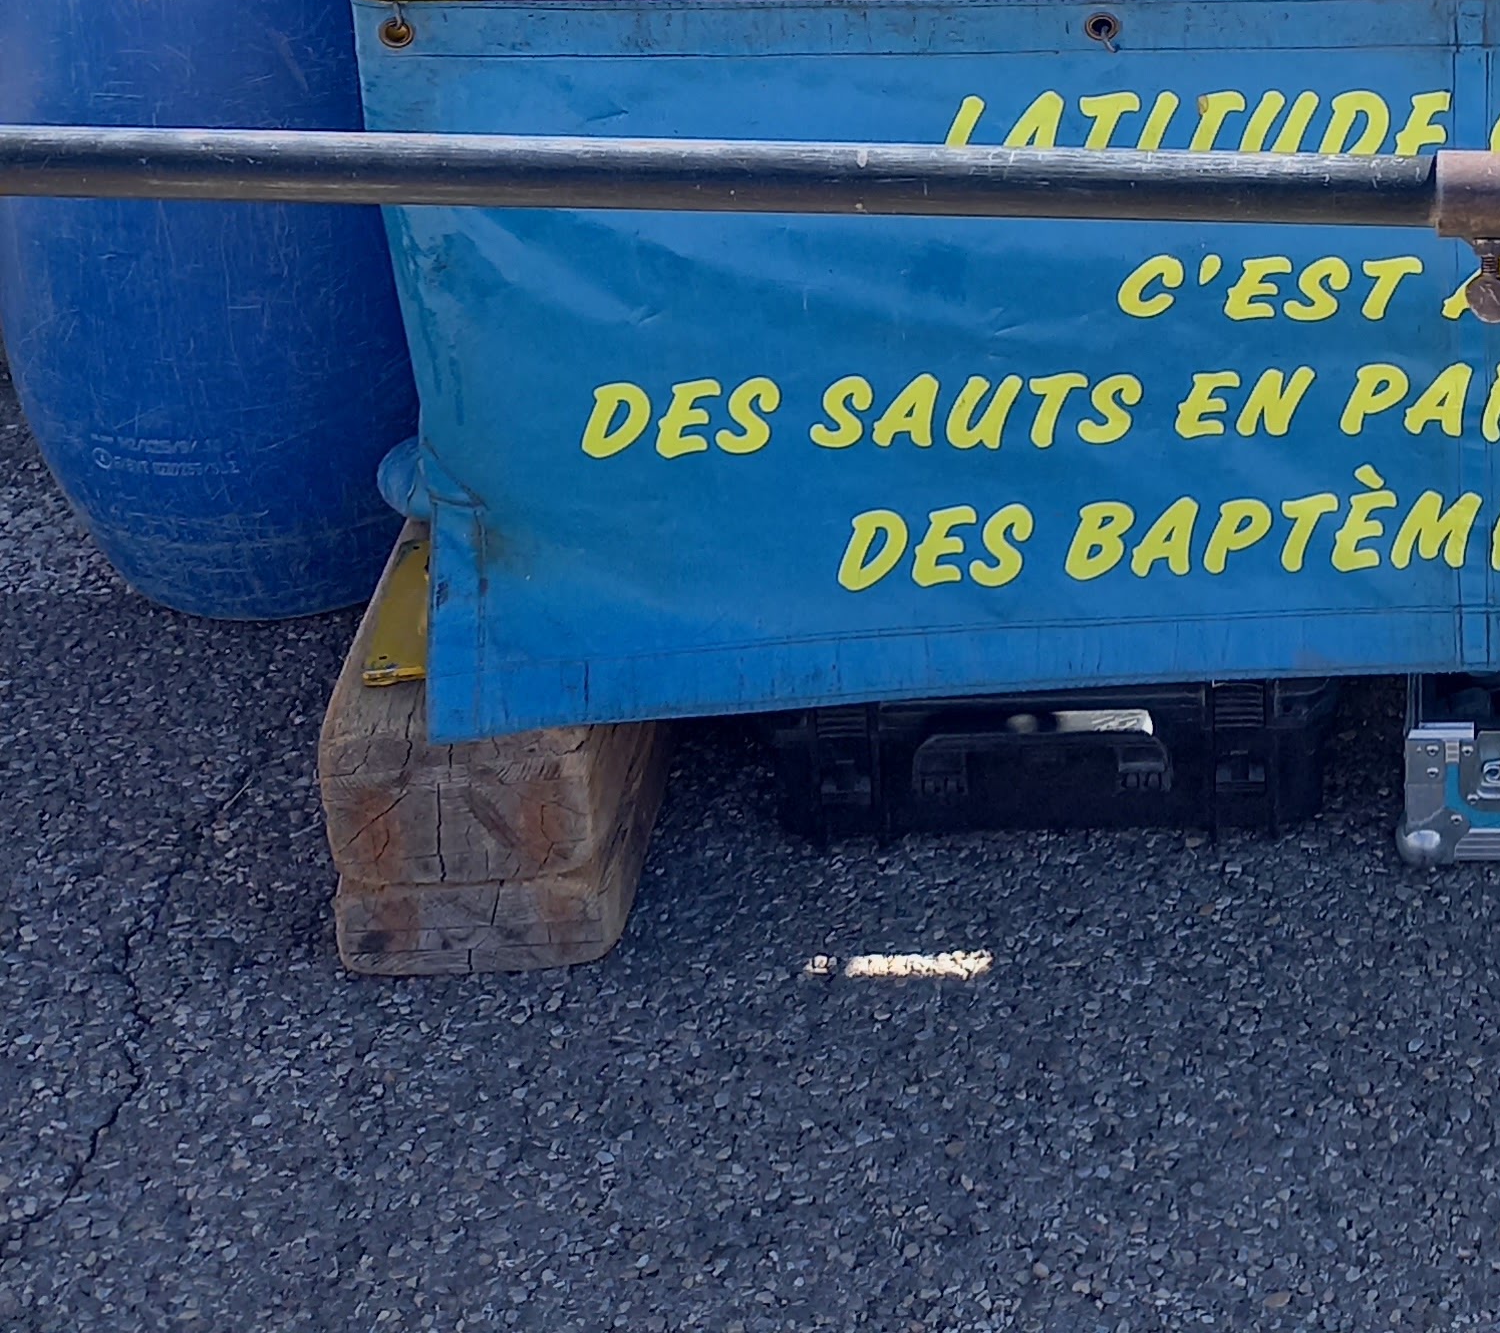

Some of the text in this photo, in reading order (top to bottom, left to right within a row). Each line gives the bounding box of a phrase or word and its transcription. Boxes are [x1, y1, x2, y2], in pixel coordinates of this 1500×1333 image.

[945, 89, 1452, 157] LATITUDE
[1117, 252, 1425, 322] C'EST
[580, 376, 781, 459] DES
[810, 372, 1143, 450] SAUTS
[1174, 366, 1316, 439] EN
[838, 503, 1033, 591] DES
